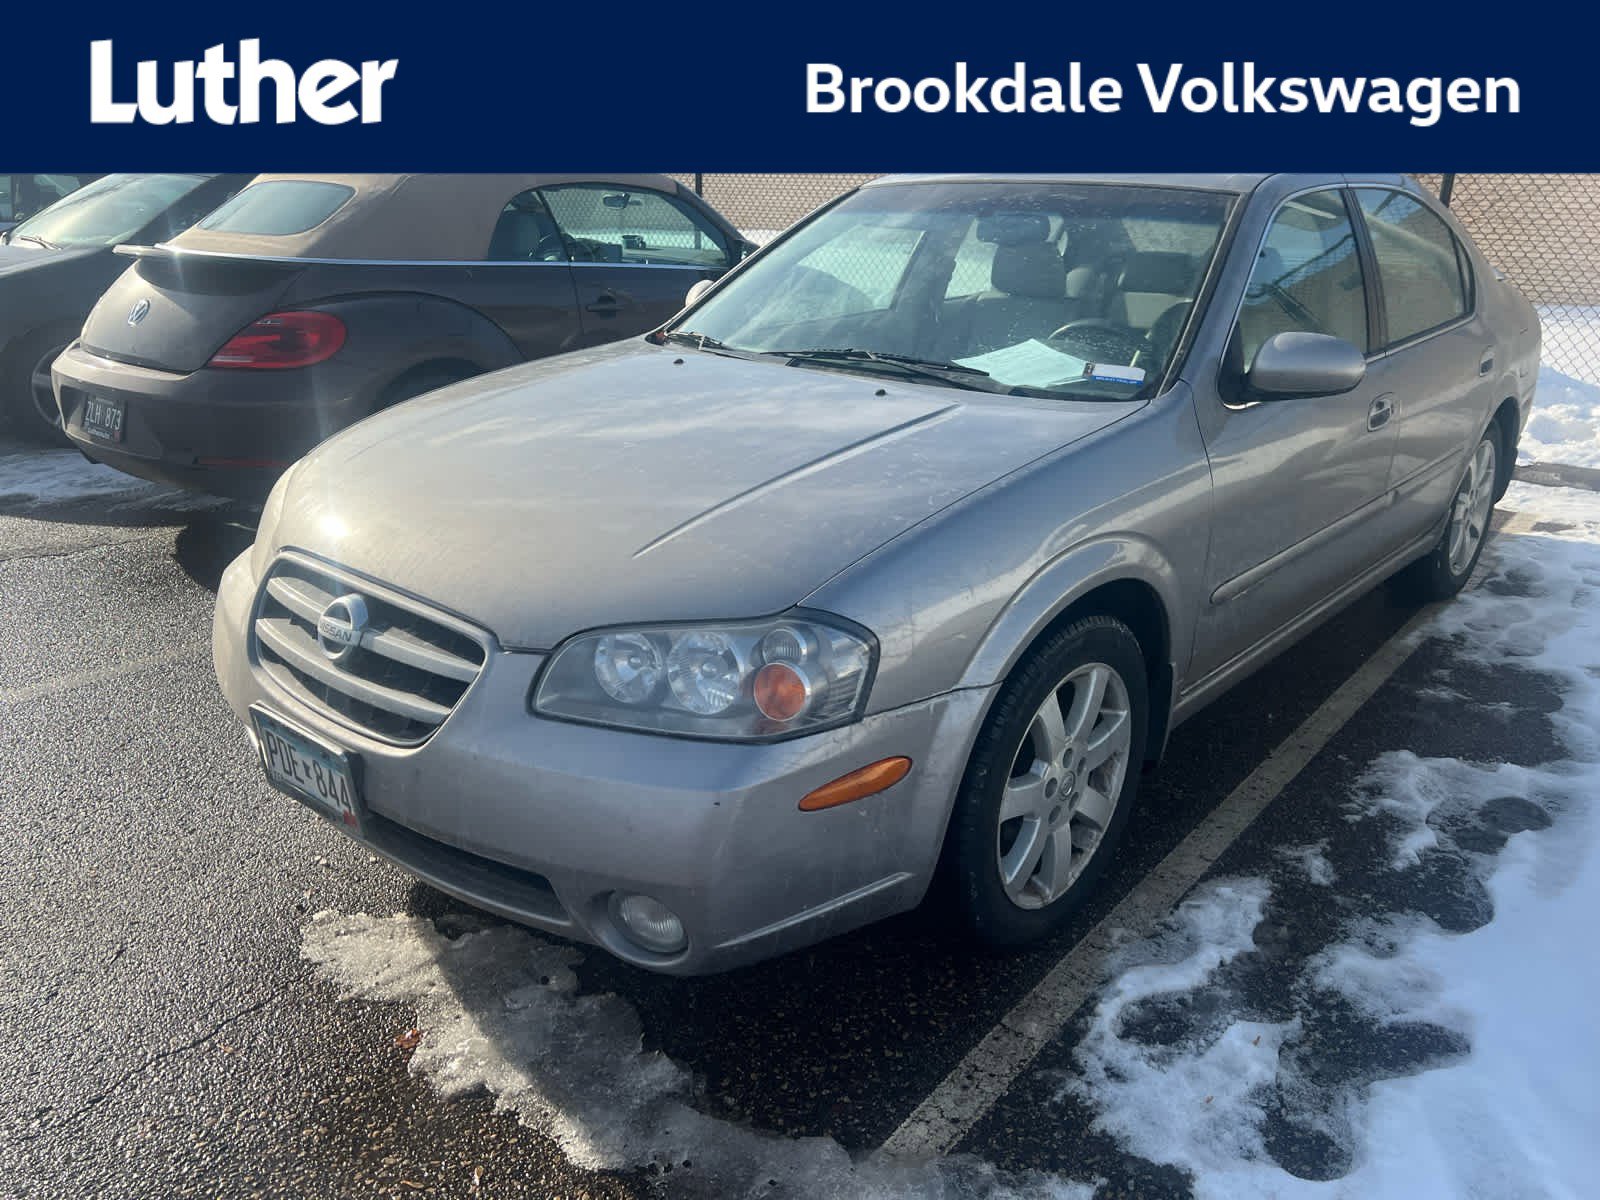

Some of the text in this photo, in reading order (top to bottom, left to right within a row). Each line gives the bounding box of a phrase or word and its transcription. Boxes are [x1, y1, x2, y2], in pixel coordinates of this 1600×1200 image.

[85, 400, 122, 431] ZLH 873
[312, 759, 352, 813] 844
